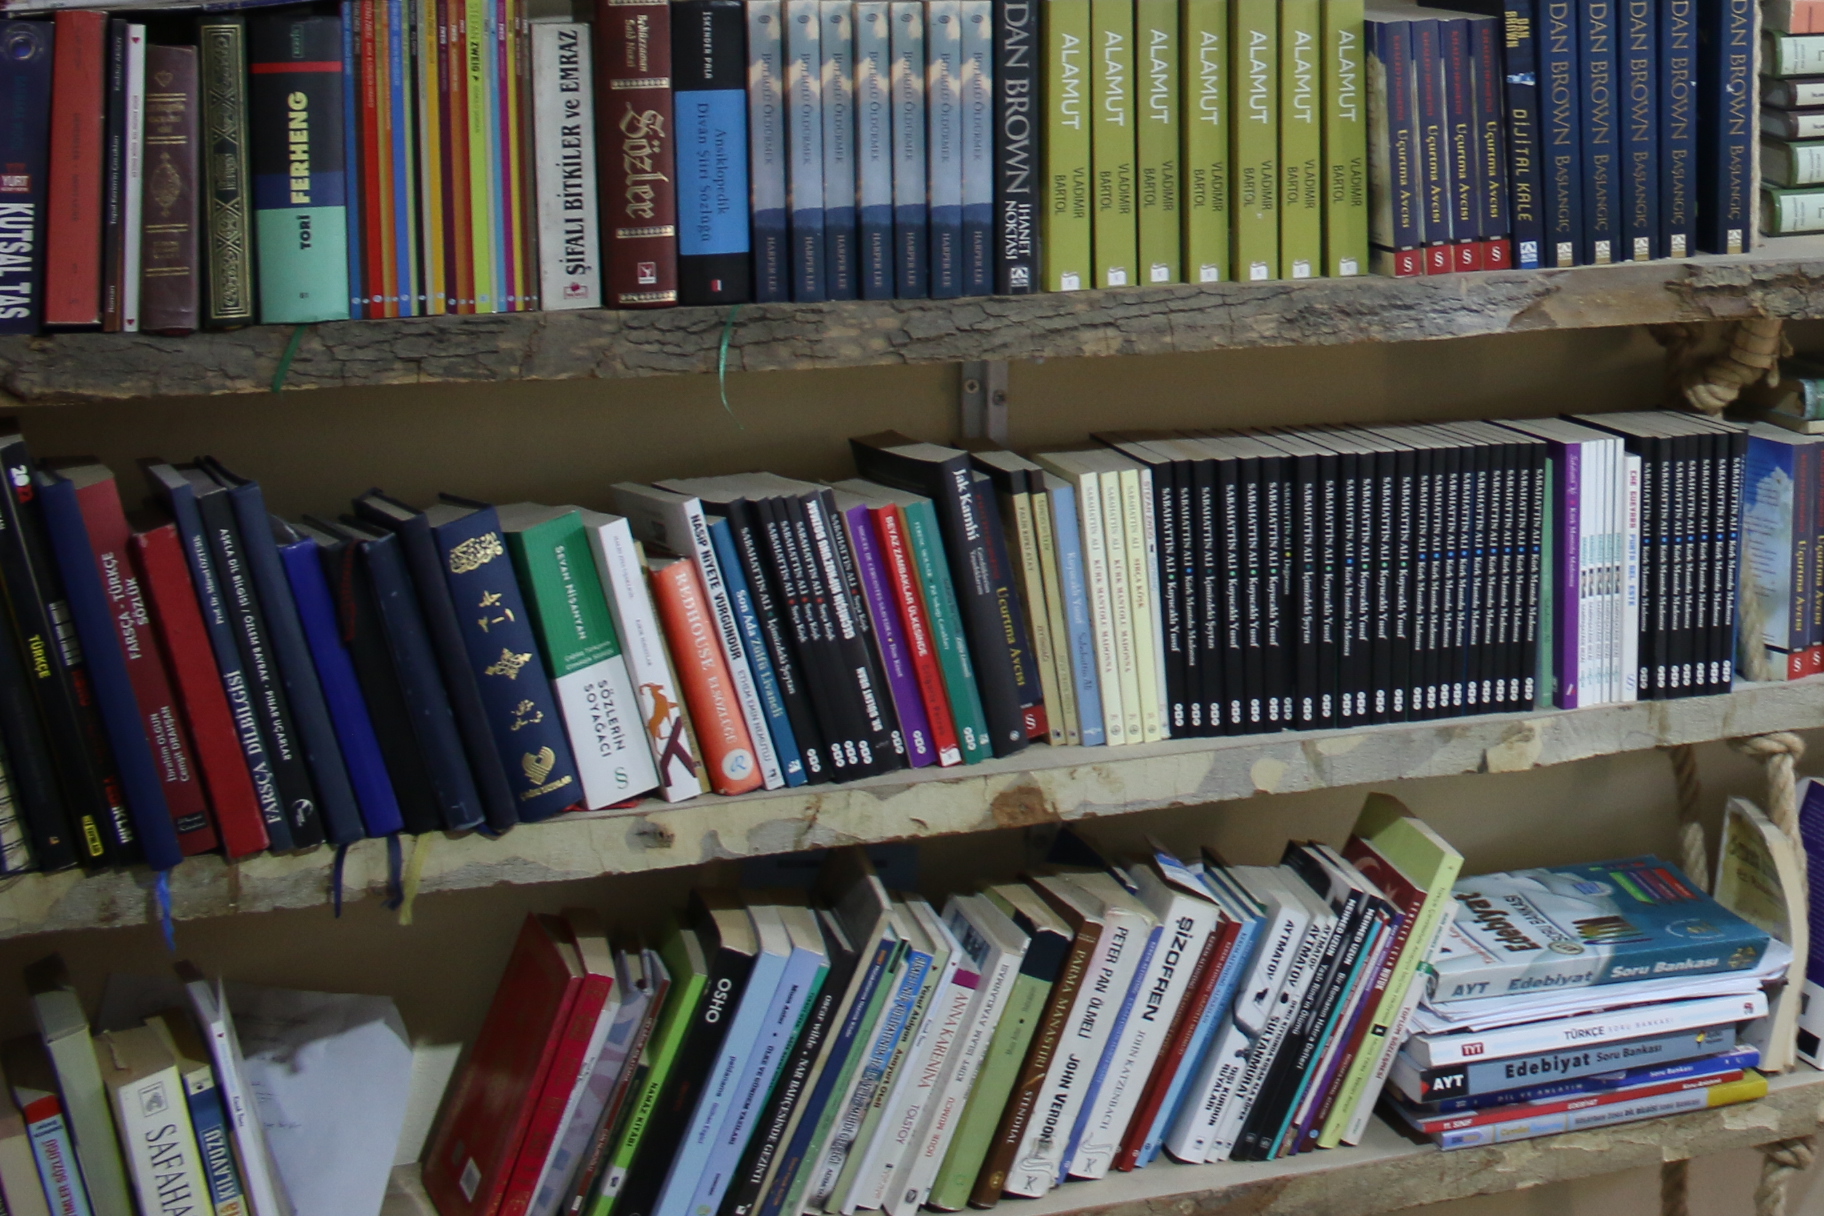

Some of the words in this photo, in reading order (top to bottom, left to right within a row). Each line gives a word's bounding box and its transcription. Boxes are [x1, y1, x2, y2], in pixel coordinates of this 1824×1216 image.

[1004, 1, 1030, 69] DAN
[1549, 2, 1569, 53] DAN
[1589, 3, 1608, 53] DAN
[1629, 1, 1648, 50] DAN
[558, 30, 581, 93] EMRAZ
[702, 51, 713, 79] PALA
[1061, 33, 1079, 130] ALAMUT
[1105, 31, 1124, 126] ALAMUT
[1150, 29, 1169, 124] ALAMUT
[1200, 31, 1218, 125] ALAMUT
[1250, 30, 1267, 124] ALAMUT
[1294, 30, 1312, 124] ALAMUT
[1338, 30, 1356, 122] ALAMUT
[570, 98, 581, 119] ve
[1550, 62, 1570, 145] BROWN
[1590, 61, 1609, 144] BROWN
[1630, 58, 1649, 142] BROWN
[288, 91, 310, 204] FERHENG
[619, 101, 669, 219] Sözler
[1005, 79, 1031, 194] BROWN
[556, 123, 583, 211] BİTKİLER
[1516, 178, 1533, 223] KALE
[1005, 200, 1017, 260] NOKTASI
[952, 467, 970, 493] Jak
[885, 516, 903, 547] BEYAZ
[958, 494, 980, 541] Kamhi
[101, 552, 126, 603] TÜRKÇE
[126, 577, 150, 626] SÖZLÜK
[118, 611, 143, 660] FARSÇA
[675, 571, 715, 671] REDHOUSE
[714, 592, 742, 662] VURGUNDUR
[735, 589, 751, 614] Son
[743, 614, 757, 637] Ada
[30, 634, 50, 679] TÜRKÇE
[150, 713, 167, 745] OLGUN
[583, 683, 611, 758] SOYAĞACI
[597, 679, 626, 752] SÖZLERİN
[252, 761, 282, 824] FARSÇA
[1334, 898, 1357, 935] MEHMED
[1353, 908, 1376, 944] MEHMED
[1103, 926, 1129, 964] PETER
[1265, 919, 1295, 981] AYTMATOV
[1288, 923, 1319, 988] AYTMATOV
[1325, 934, 1343, 957] UZUN
[1344, 943, 1360, 966] UZUN
[1058, 949, 1087, 995] PARMA
[1094, 968, 1114, 993] PAN
[1451, 981, 1490, 997] AYT
[1508, 971, 1594, 992] Edebiyat
[1610, 963, 1650, 979] Soru
[1654, 956, 1720, 975] Bankası
[705, 978, 731, 1024] OSHO
[944, 991, 970, 1026] ANNA
[1126, 1029, 1146, 1059] JOHN
[1235, 1014, 1280, 1100] SULTANMURAT
[1563, 1024, 1606, 1041] TÜRKÇE
[1059, 1053, 1081, 1091] JOHN
[1432, 1074, 1464, 1091] AYT
[1505, 1052, 1591, 1079] Edebiyat
[1596, 1049, 1620, 1064] Soru
[1621, 1042, 1663, 1059] Bankası
[894, 1103, 921, 1145] TOLSTOY
